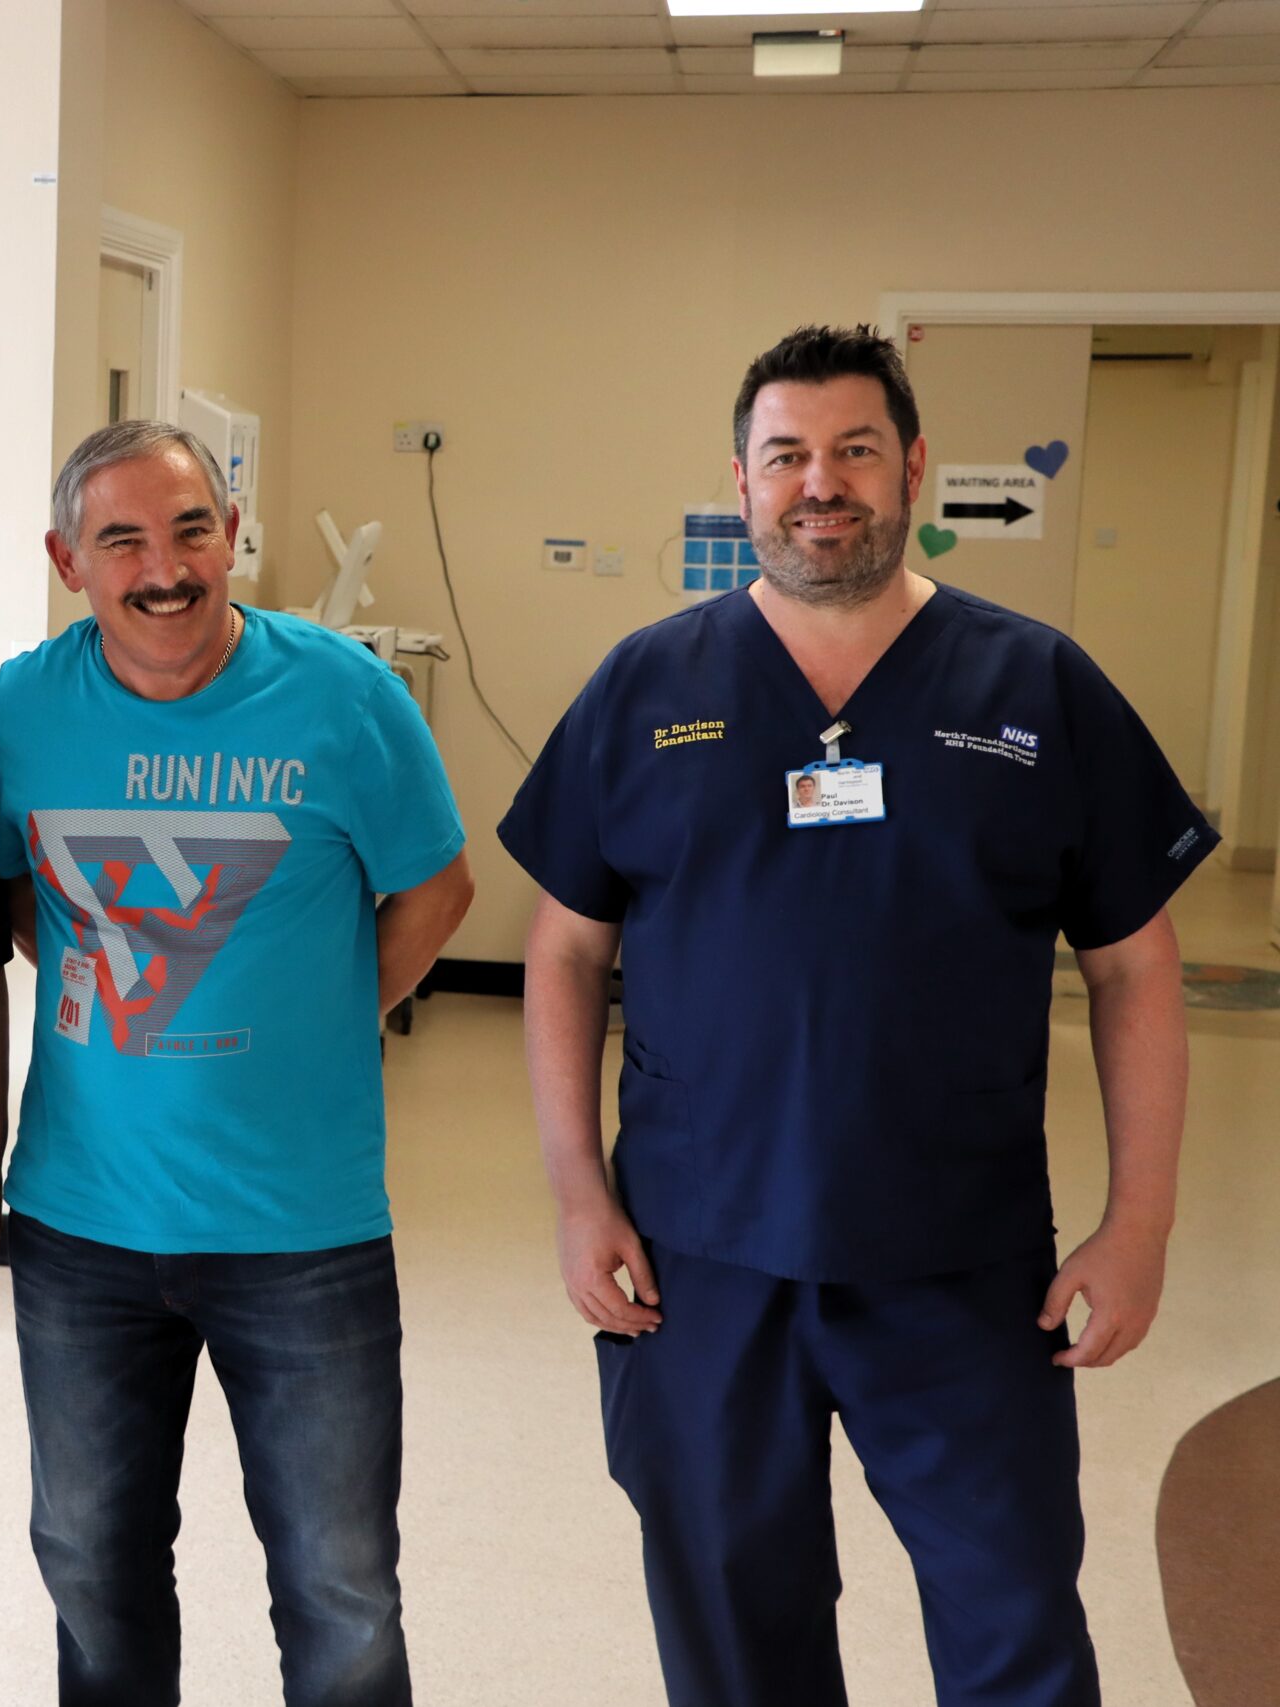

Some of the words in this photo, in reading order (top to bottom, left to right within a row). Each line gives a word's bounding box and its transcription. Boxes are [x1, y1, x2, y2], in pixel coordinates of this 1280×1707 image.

[946, 477, 1000, 488] WAITING
[1003, 477, 1036, 488] AREA
[654, 728, 669, 740] Dr
[671, 719, 725, 735] Davison
[655, 730, 723, 749] Consultant
[1002, 727, 1038, 748] NHS
[1014, 754, 1036, 766] Trust
[833, 799, 864, 807] Davison
[794, 810, 830, 819] Cardiology
[832, 808, 869, 816] Consultant
